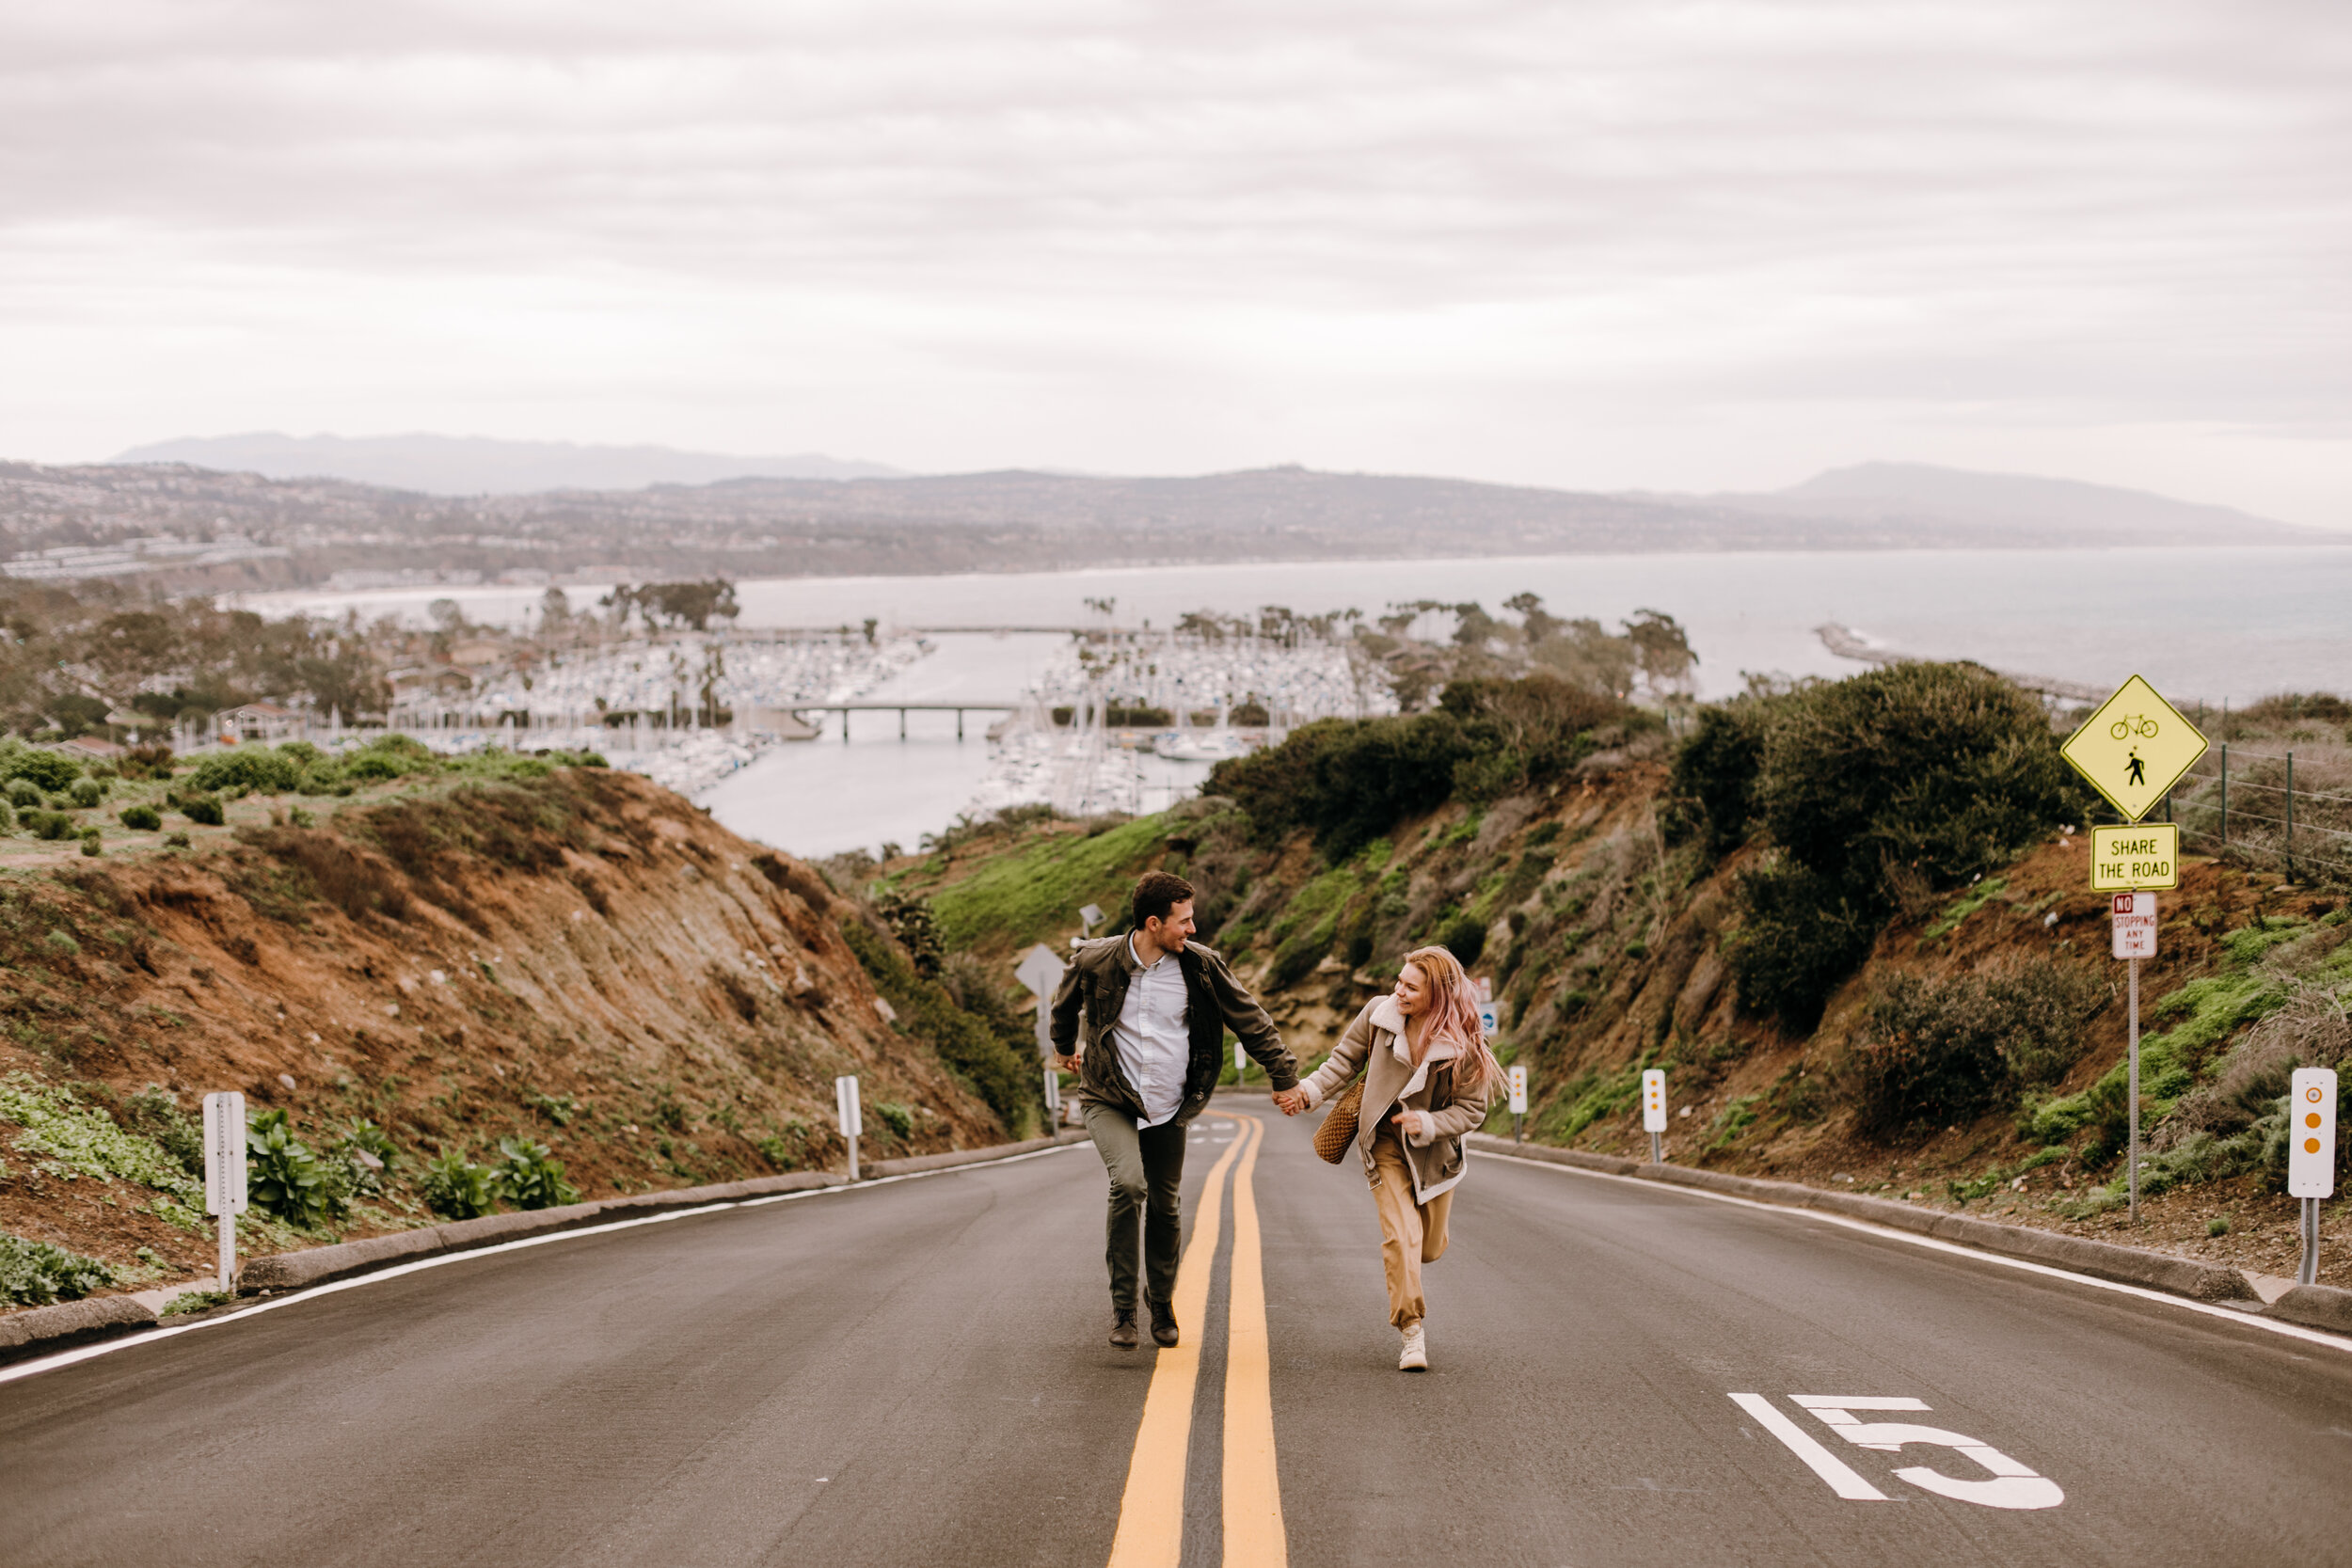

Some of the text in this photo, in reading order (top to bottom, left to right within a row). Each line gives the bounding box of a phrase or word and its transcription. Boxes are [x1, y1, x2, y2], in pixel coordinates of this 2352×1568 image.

[2111, 839, 2157, 856] SHARE
[2100, 862, 2169, 879] THE ROAD
[2116, 896, 2132, 911] NO
[2115, 915, 2154, 928] STOPPING
[2126, 930, 2143, 939] ANY
[2125, 941, 2145, 950] TIME
[1727, 1393, 2065, 1510] 15
